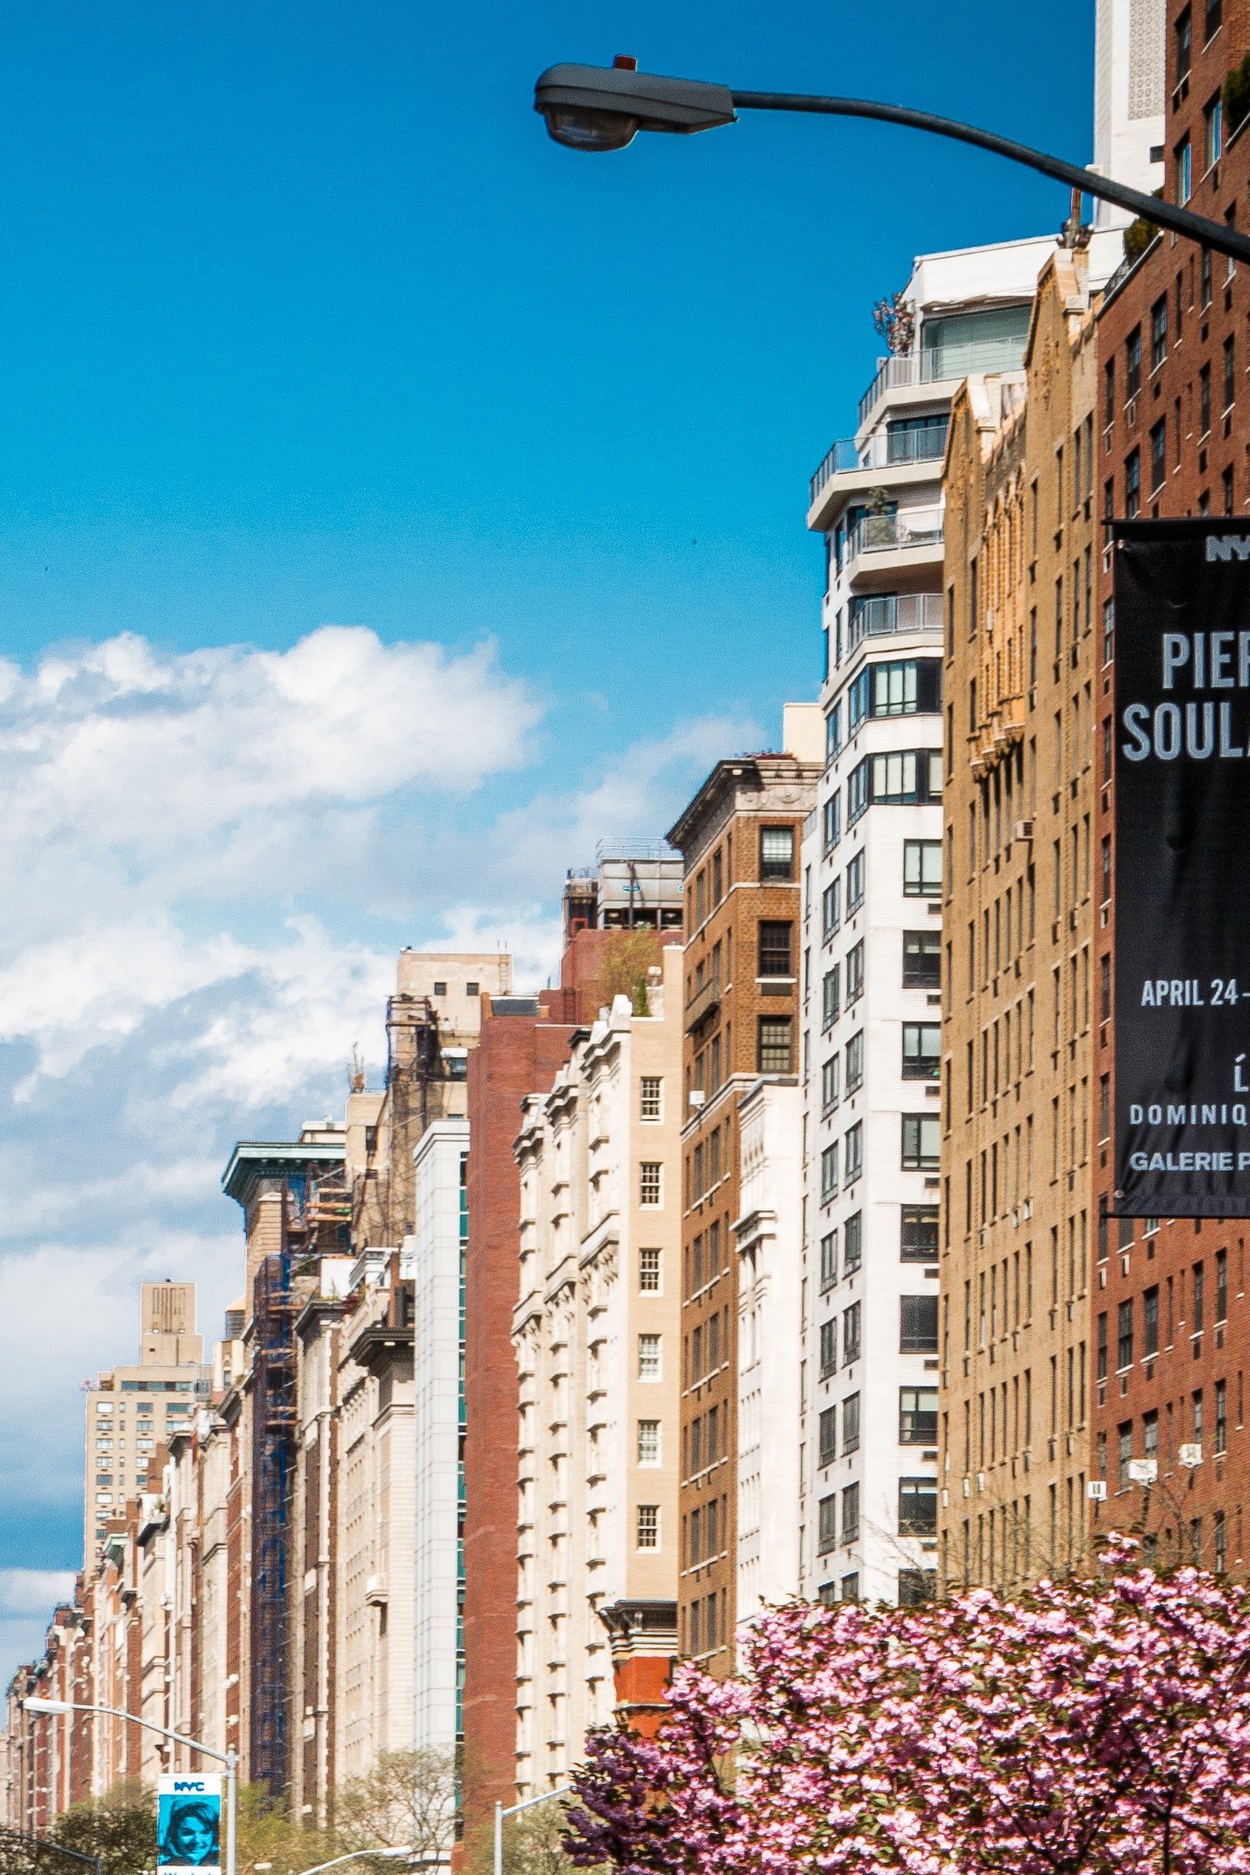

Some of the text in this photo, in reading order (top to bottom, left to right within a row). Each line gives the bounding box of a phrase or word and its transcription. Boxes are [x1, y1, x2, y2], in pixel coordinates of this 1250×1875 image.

[1122, 701, 1250, 761] SOUL
[1141, 979, 1204, 1006] APRIL
[1130, 1104, 1248, 1126] DOMINIQ
[1130, 1152, 1234, 1171] GALERIE
[174, 1781, 205, 1792] NYC
